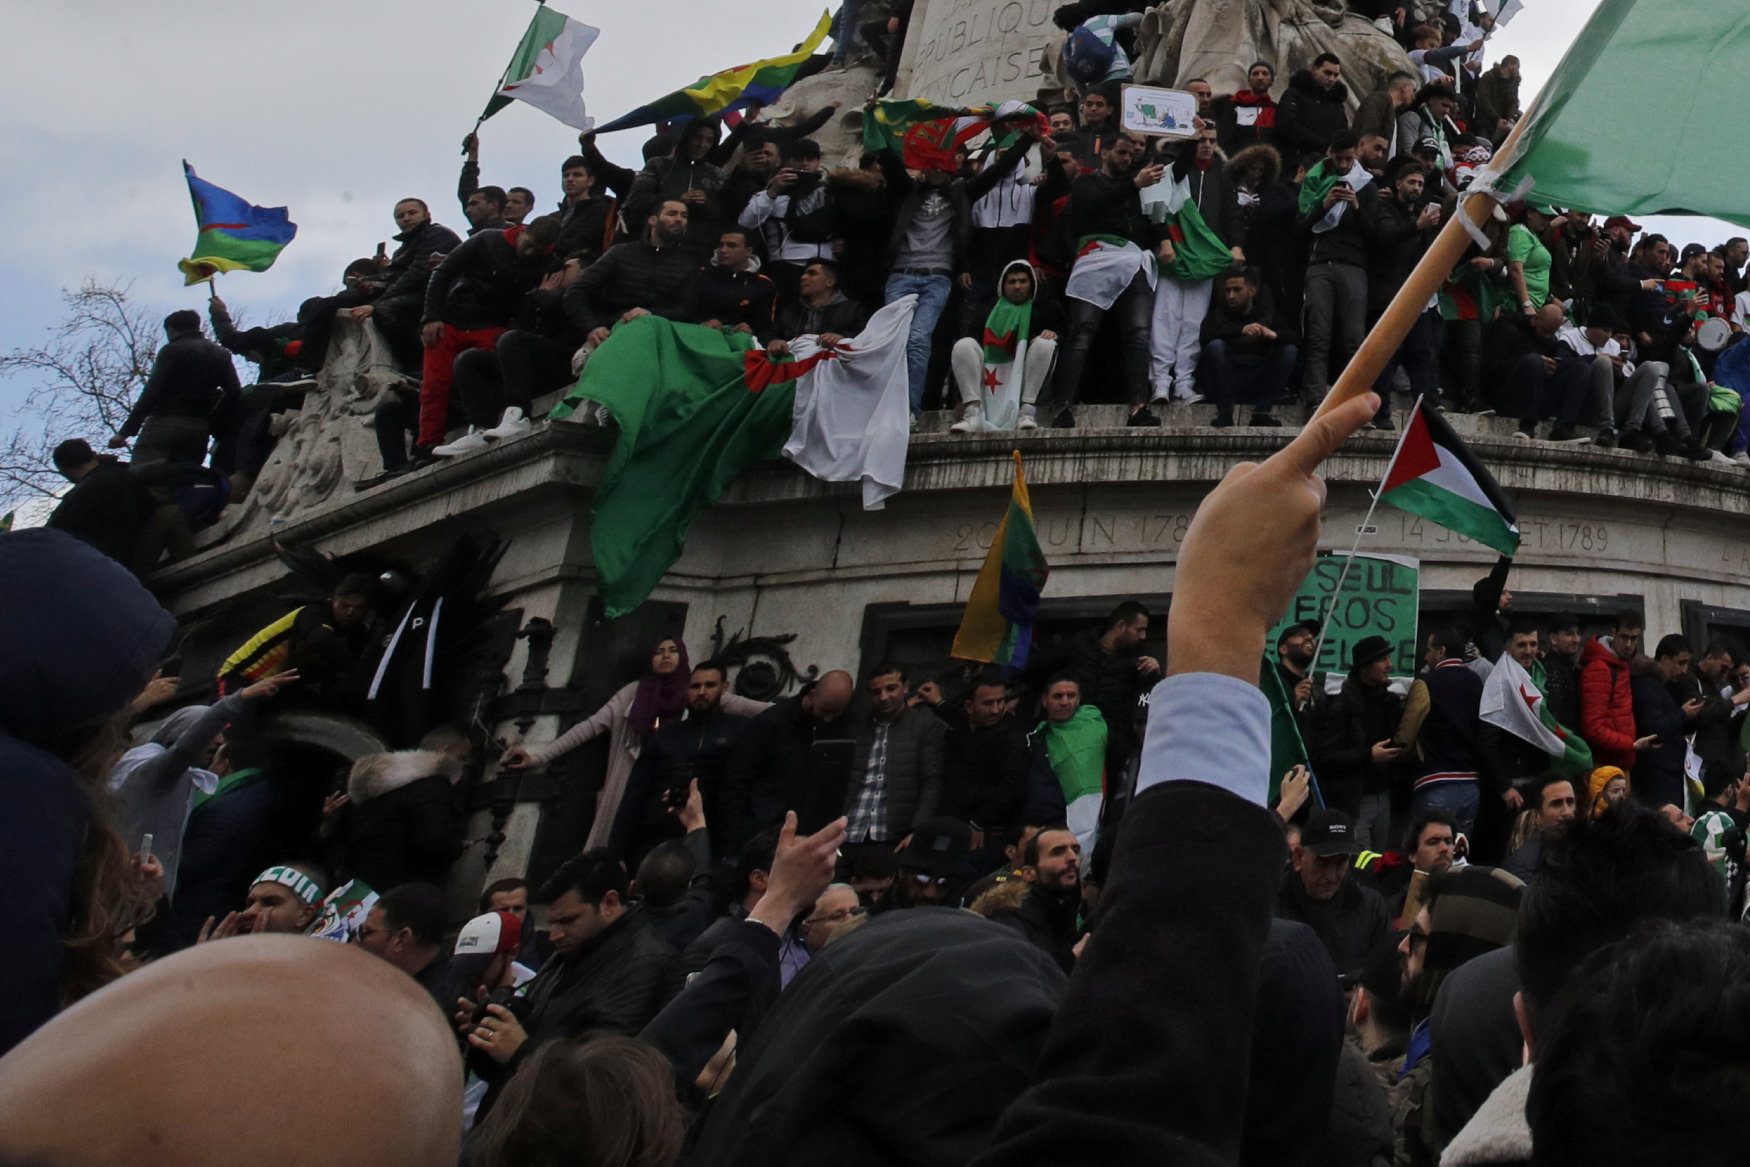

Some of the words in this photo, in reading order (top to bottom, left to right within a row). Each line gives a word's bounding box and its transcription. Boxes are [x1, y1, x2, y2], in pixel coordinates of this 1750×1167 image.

[1037, 515, 1116, 546] UIN
[1141, 514, 1190, 544] 178
[1401, 514, 1424, 542] 14
[1560, 523, 1608, 552] 1789
[1314, 558, 1413, 596] SEUL
[1292, 595, 1398, 632] EROS
